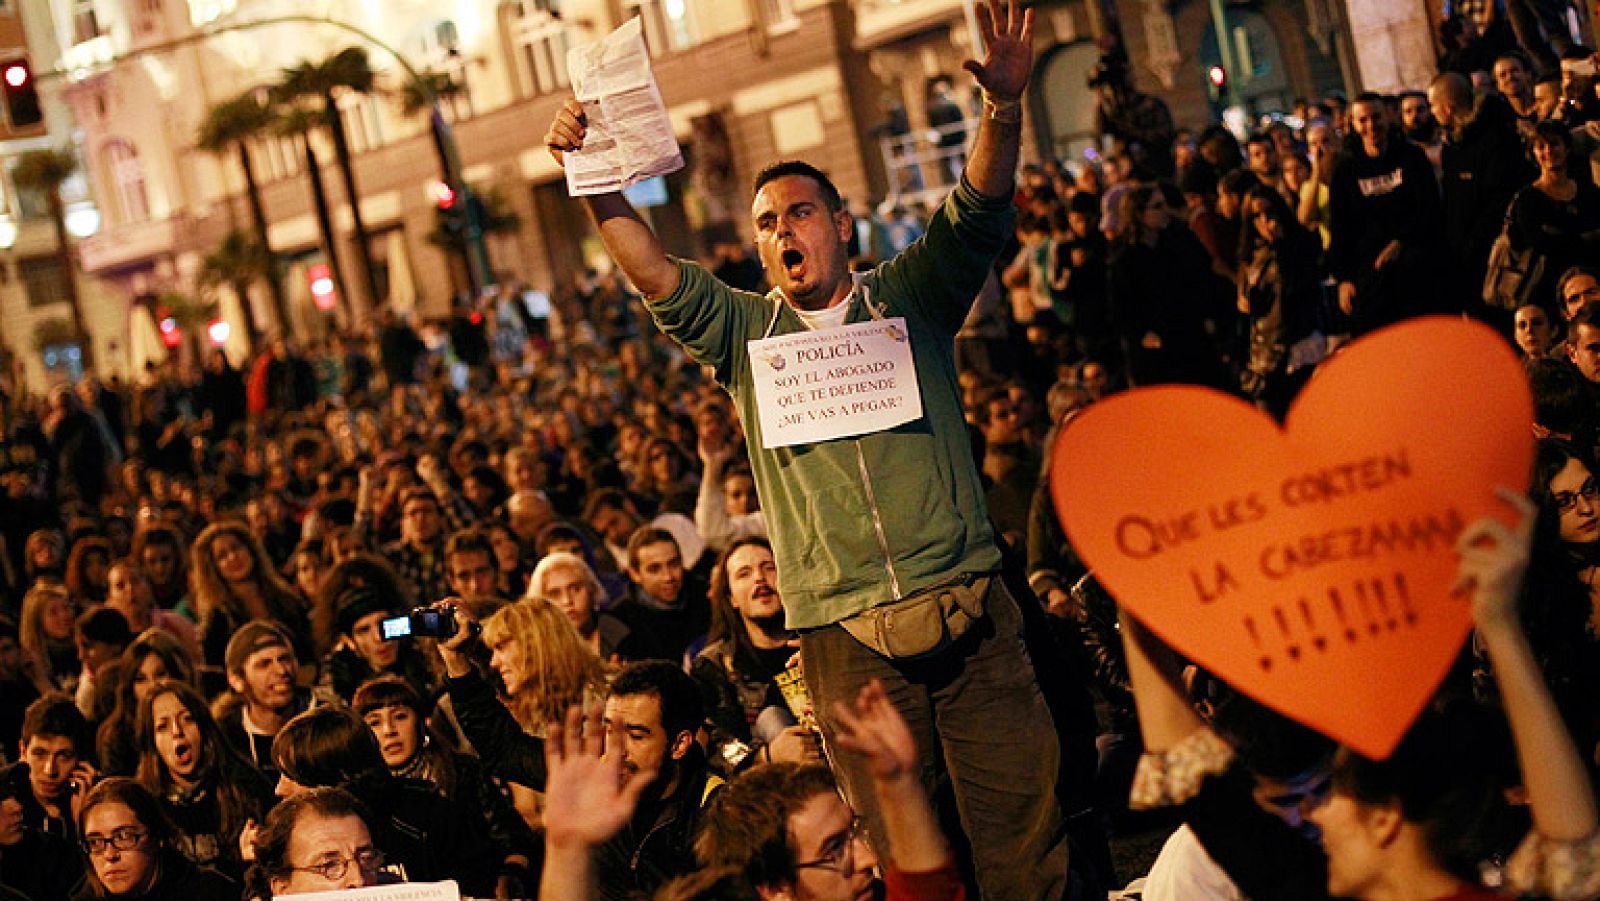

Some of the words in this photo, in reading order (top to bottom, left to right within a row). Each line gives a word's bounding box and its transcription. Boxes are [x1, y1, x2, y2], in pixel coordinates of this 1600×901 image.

[796, 340, 865, 364] POLICÍA
[775, 374, 801, 389] SOY
[805, 370, 823, 385] EL
[826, 360, 895, 381] ABOGADO
[777, 391, 806, 408] QUE
[809, 387, 827, 401] TE
[828, 377, 896, 398] DEFIENDE
[777, 412, 804, 428] ¿ME
[807, 405, 836, 420] VAS
[840, 403, 849, 416] A
[851, 395, 902, 414] PEGAR?
[1208, 492, 1267, 532] LES
[1190, 560, 1240, 604] LA
